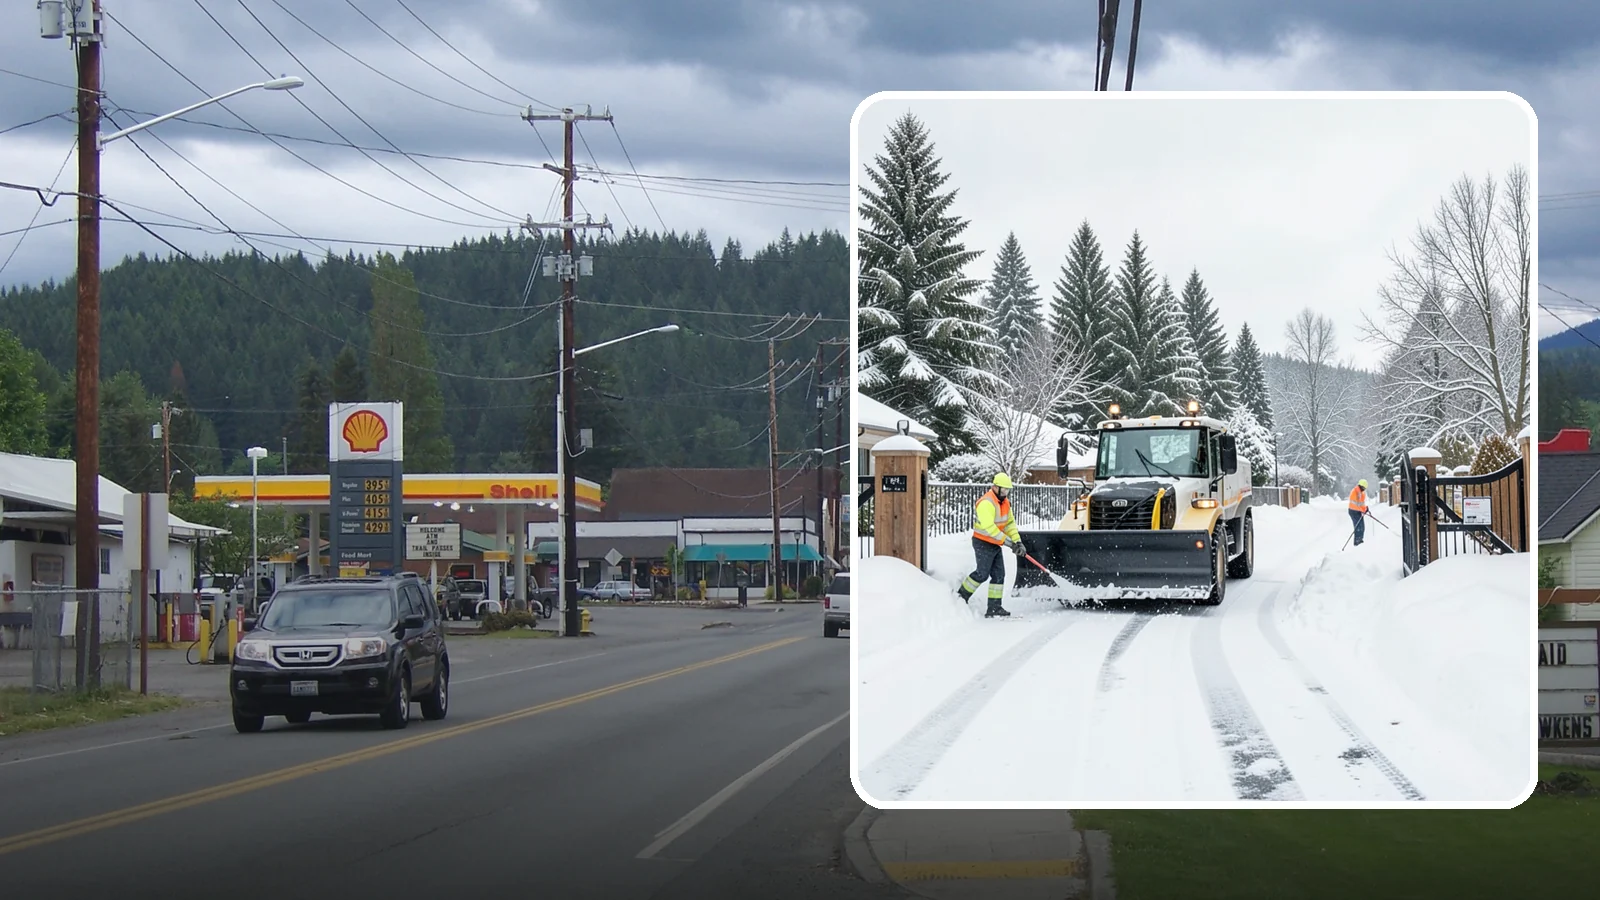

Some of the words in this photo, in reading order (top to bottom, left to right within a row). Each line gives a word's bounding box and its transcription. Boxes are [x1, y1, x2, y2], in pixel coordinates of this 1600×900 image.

[342, 482, 358, 490] Regular
[366, 479, 383, 490] 395
[490, 484, 547, 499] Shell
[366, 494, 383, 504] 405
[366, 508, 383, 518] 415
[366, 522, 383, 532] 429
[1539, 643, 1566, 665] AID
[1539, 716, 1592, 738] WKENS
